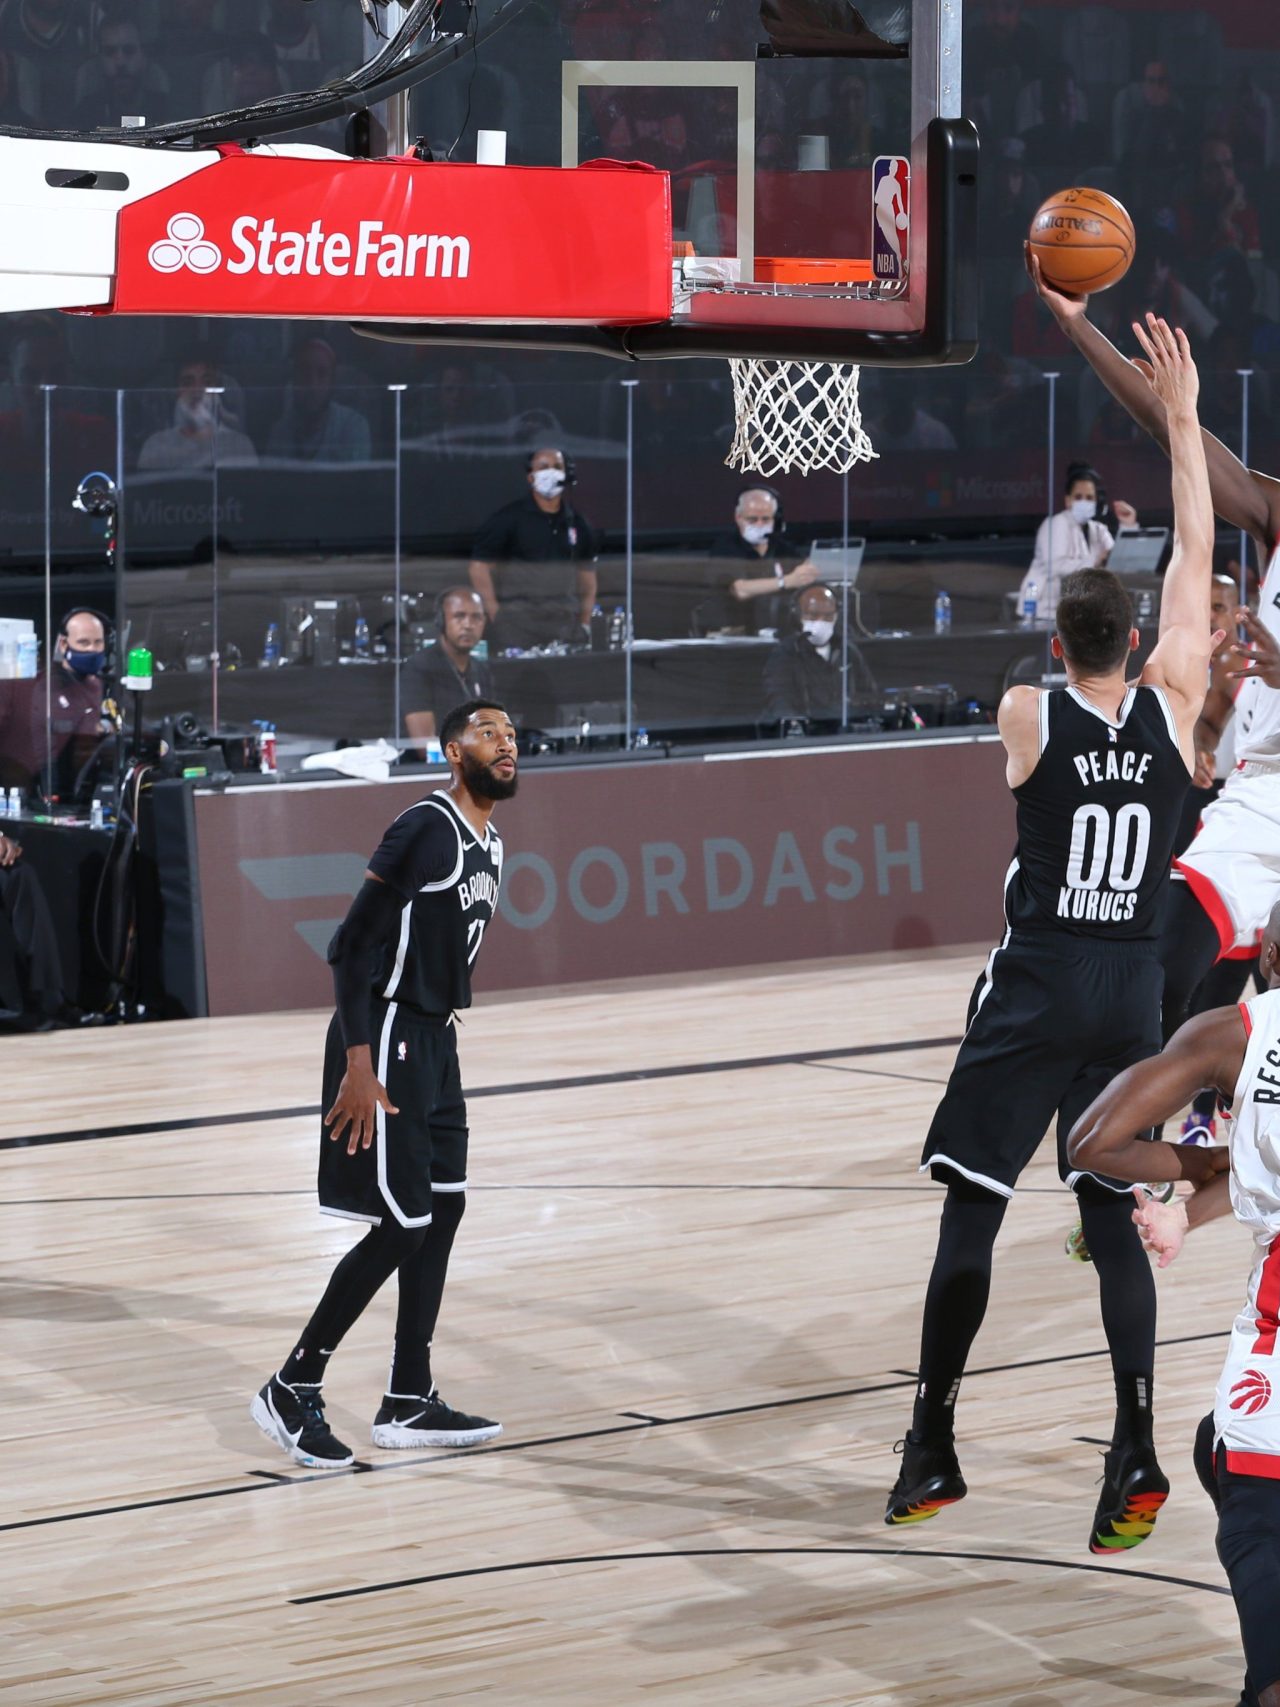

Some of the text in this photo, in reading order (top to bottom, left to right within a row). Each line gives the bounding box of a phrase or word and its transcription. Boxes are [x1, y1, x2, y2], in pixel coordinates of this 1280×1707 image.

[876, 253, 896, 274] NBA
[133, 496, 243, 526] Microsoft
[1072, 749, 1153, 787] PEACE
[1065, 802, 1151, 891] 00
[498, 820, 926, 930] OORDASH
[1056, 886, 1139, 922] KURUCS
